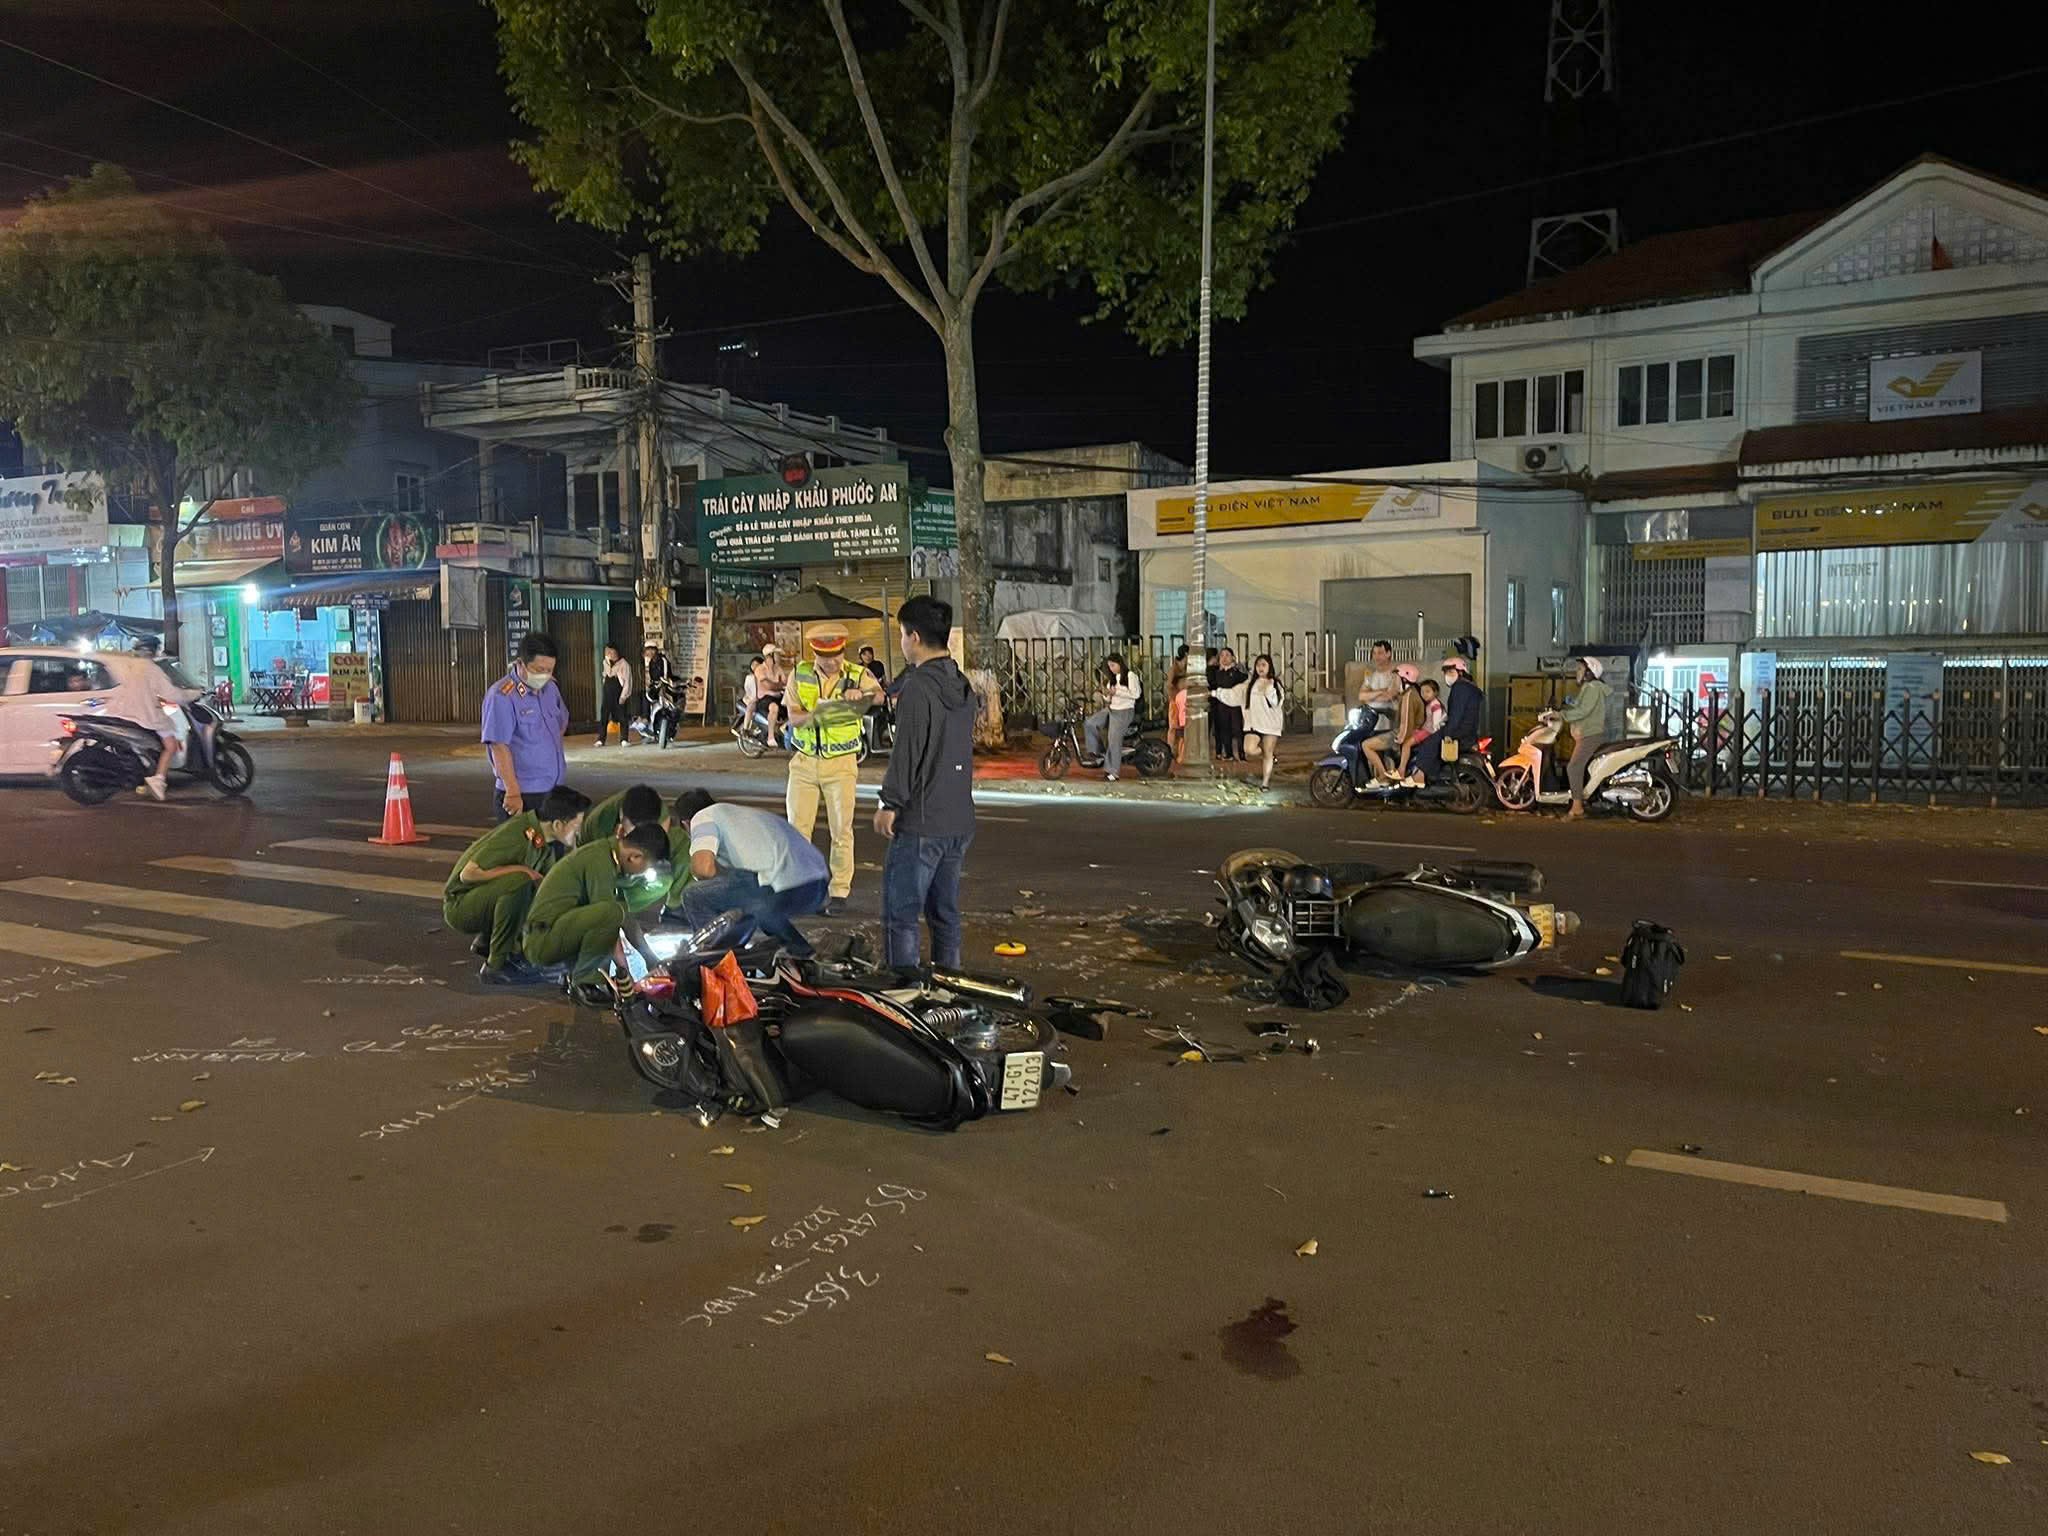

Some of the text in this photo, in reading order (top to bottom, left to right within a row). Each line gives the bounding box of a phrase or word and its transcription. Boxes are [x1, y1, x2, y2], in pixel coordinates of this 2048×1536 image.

[1877, 401, 1934, 413] VIETNAM
[703, 478, 897, 515] TRÁI CÂY NHẬP KHẨU PHƯỚC AN
[1255, 498, 1285, 510] VIỆT
[1289, 496, 1321, 506] NAM
[1903, 500, 1944, 512] NAM
[311, 533, 361, 553] KIM ÂN
[1827, 562, 1879, 578] INTERNET
[332, 667, 350, 676] KIM
[1021, 1055, 1041, 1104] 122.03
